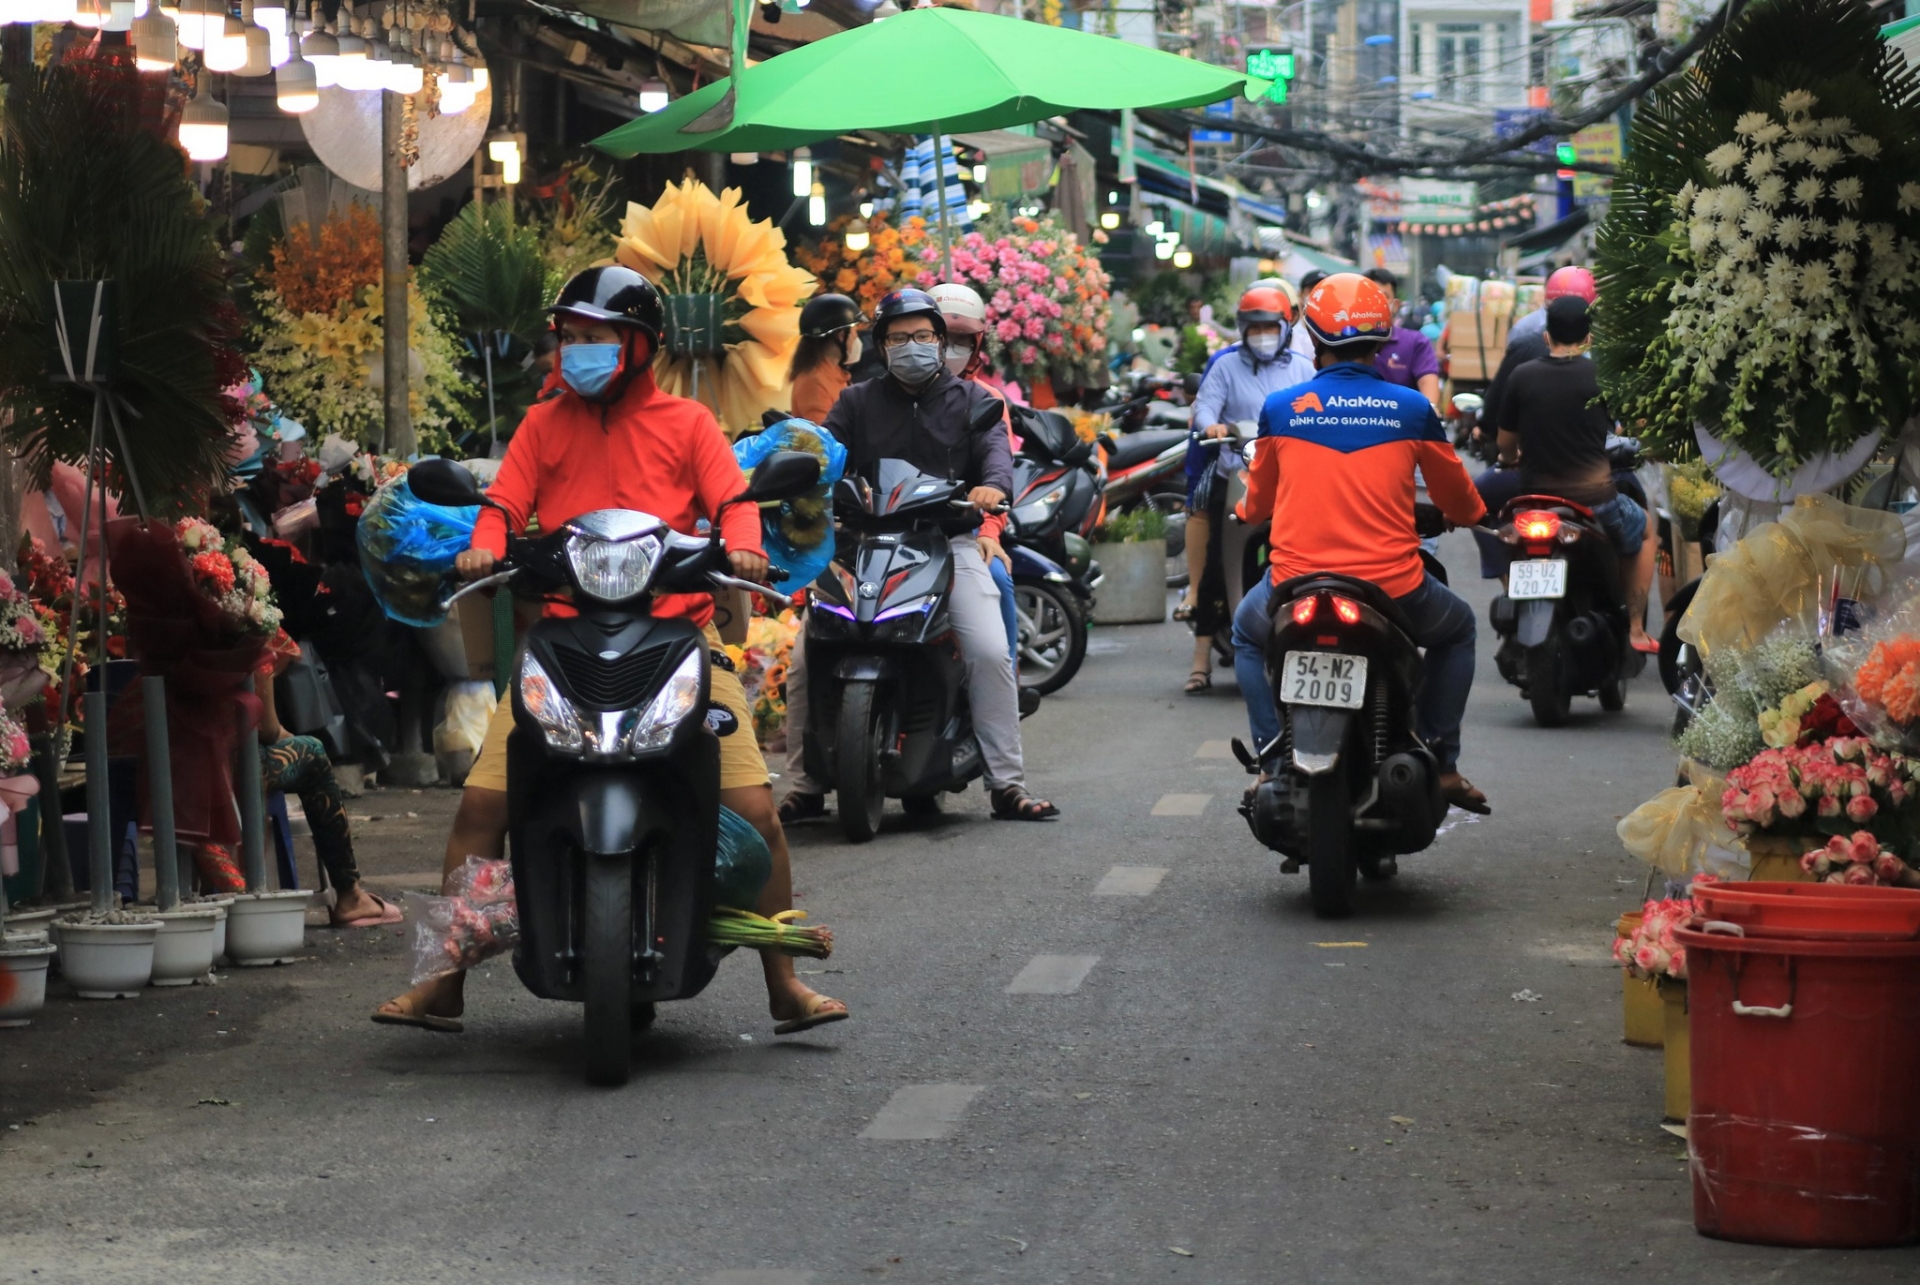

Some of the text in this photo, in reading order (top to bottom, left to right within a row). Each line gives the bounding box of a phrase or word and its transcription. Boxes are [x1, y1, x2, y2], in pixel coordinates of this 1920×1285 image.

[1351, 311, 1383, 320] AhaMove
[1326, 395, 1398, 410] AhaMove
[1316, 415, 1339, 426] CAO
[1341, 416, 1369, 427] GIAO
[1370, 413, 1401, 429] HÀNG
[1518, 563, 1556, 579] 59-U2
[1513, 579, 1559, 595] 420.74
[1297, 656, 1354, 680] 54-N2
[1293, 678, 1352, 703] 2009
